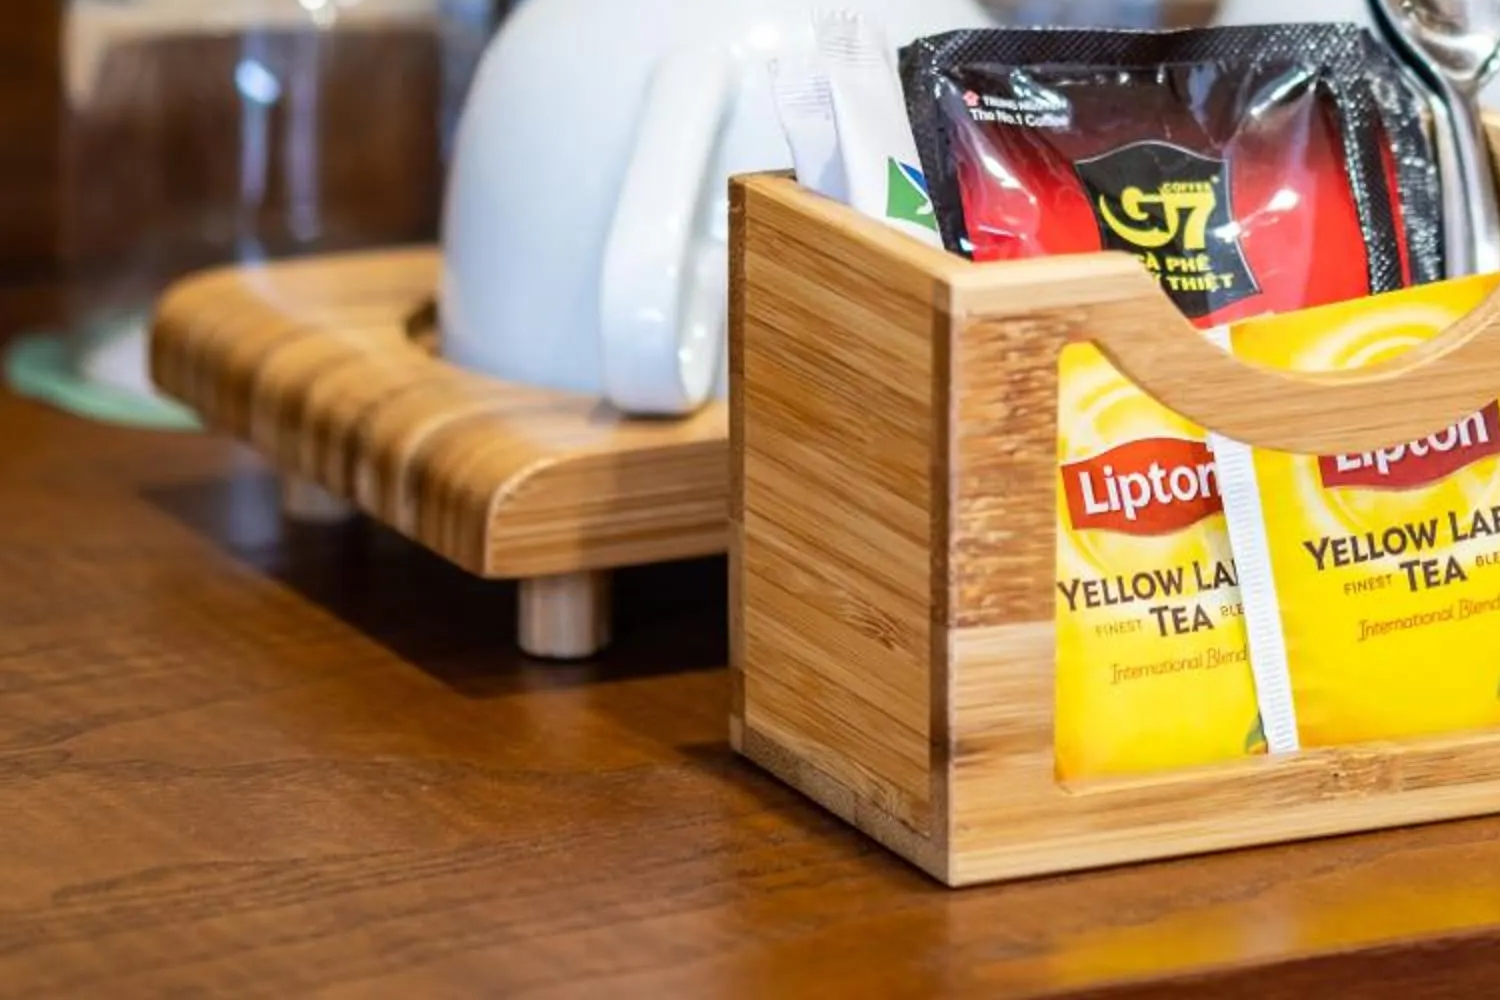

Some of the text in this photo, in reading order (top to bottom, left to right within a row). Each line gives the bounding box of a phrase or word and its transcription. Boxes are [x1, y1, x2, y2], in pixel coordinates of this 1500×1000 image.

[968, 108, 996, 121] The
[1099, 186, 1216, 250] G7
[1078, 461, 1223, 520] Lipton
[1302, 517, 1439, 572] YELLOW
[1056, 559, 1240, 612] YELLOW LA
[1343, 573, 1393, 596] FINEST
[1399, 556, 1468, 593] TEA
[1094, 602, 1246, 639] FINEST TEA BLE
[1356, 604, 1456, 643] International
[1109, 643, 1249, 686] International Blend
